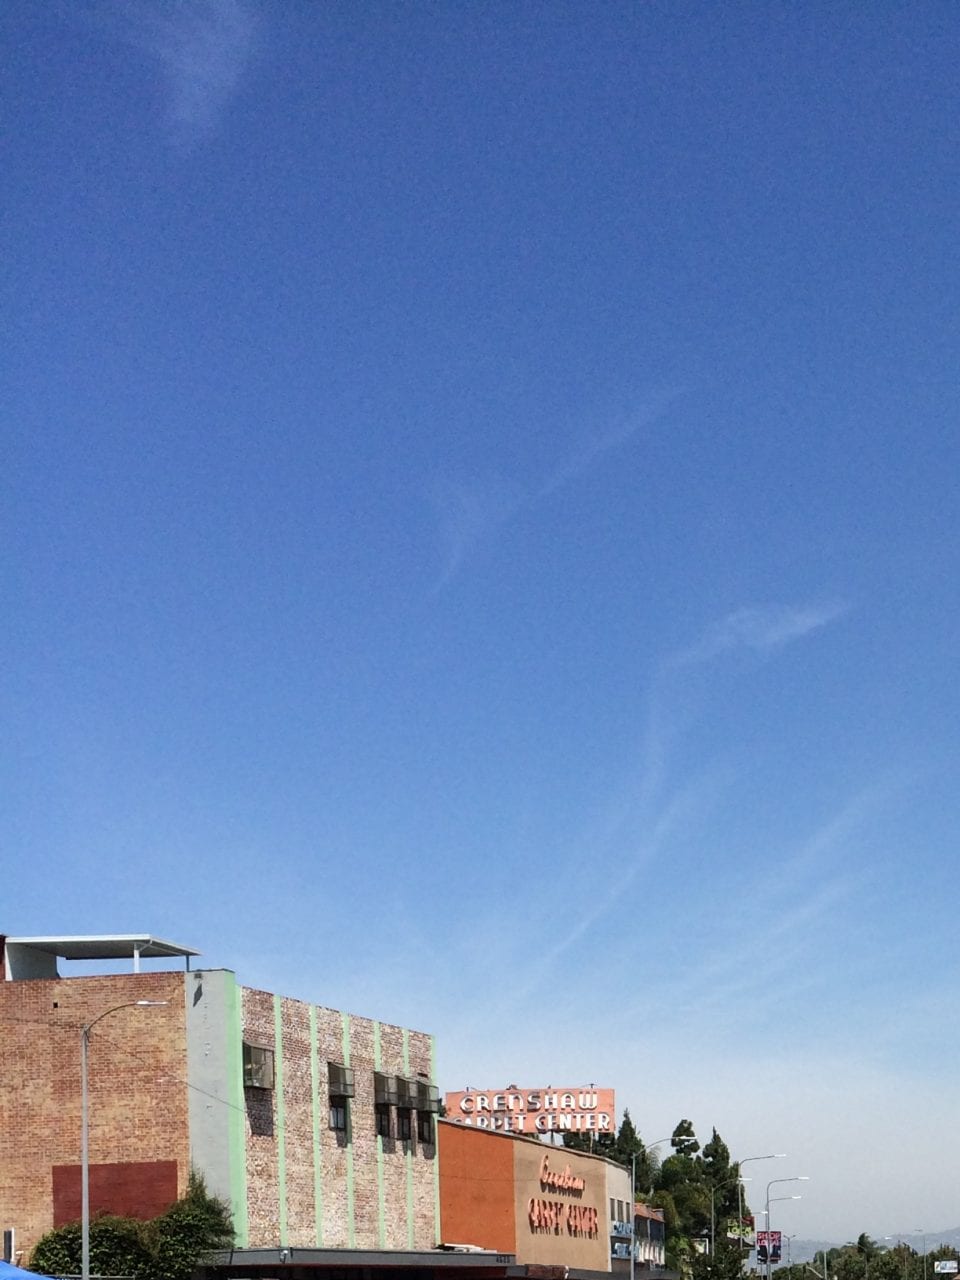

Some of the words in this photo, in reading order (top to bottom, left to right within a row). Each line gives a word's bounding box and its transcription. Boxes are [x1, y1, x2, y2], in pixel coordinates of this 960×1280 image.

[459, 1092, 598, 1113] CRENSHAW
[453, 1113, 526, 1132] RPET
[534, 1112, 611, 1132] CENTER
[528, 1198, 563, 1227] CARPET
[567, 1203, 598, 1233] CENTER
